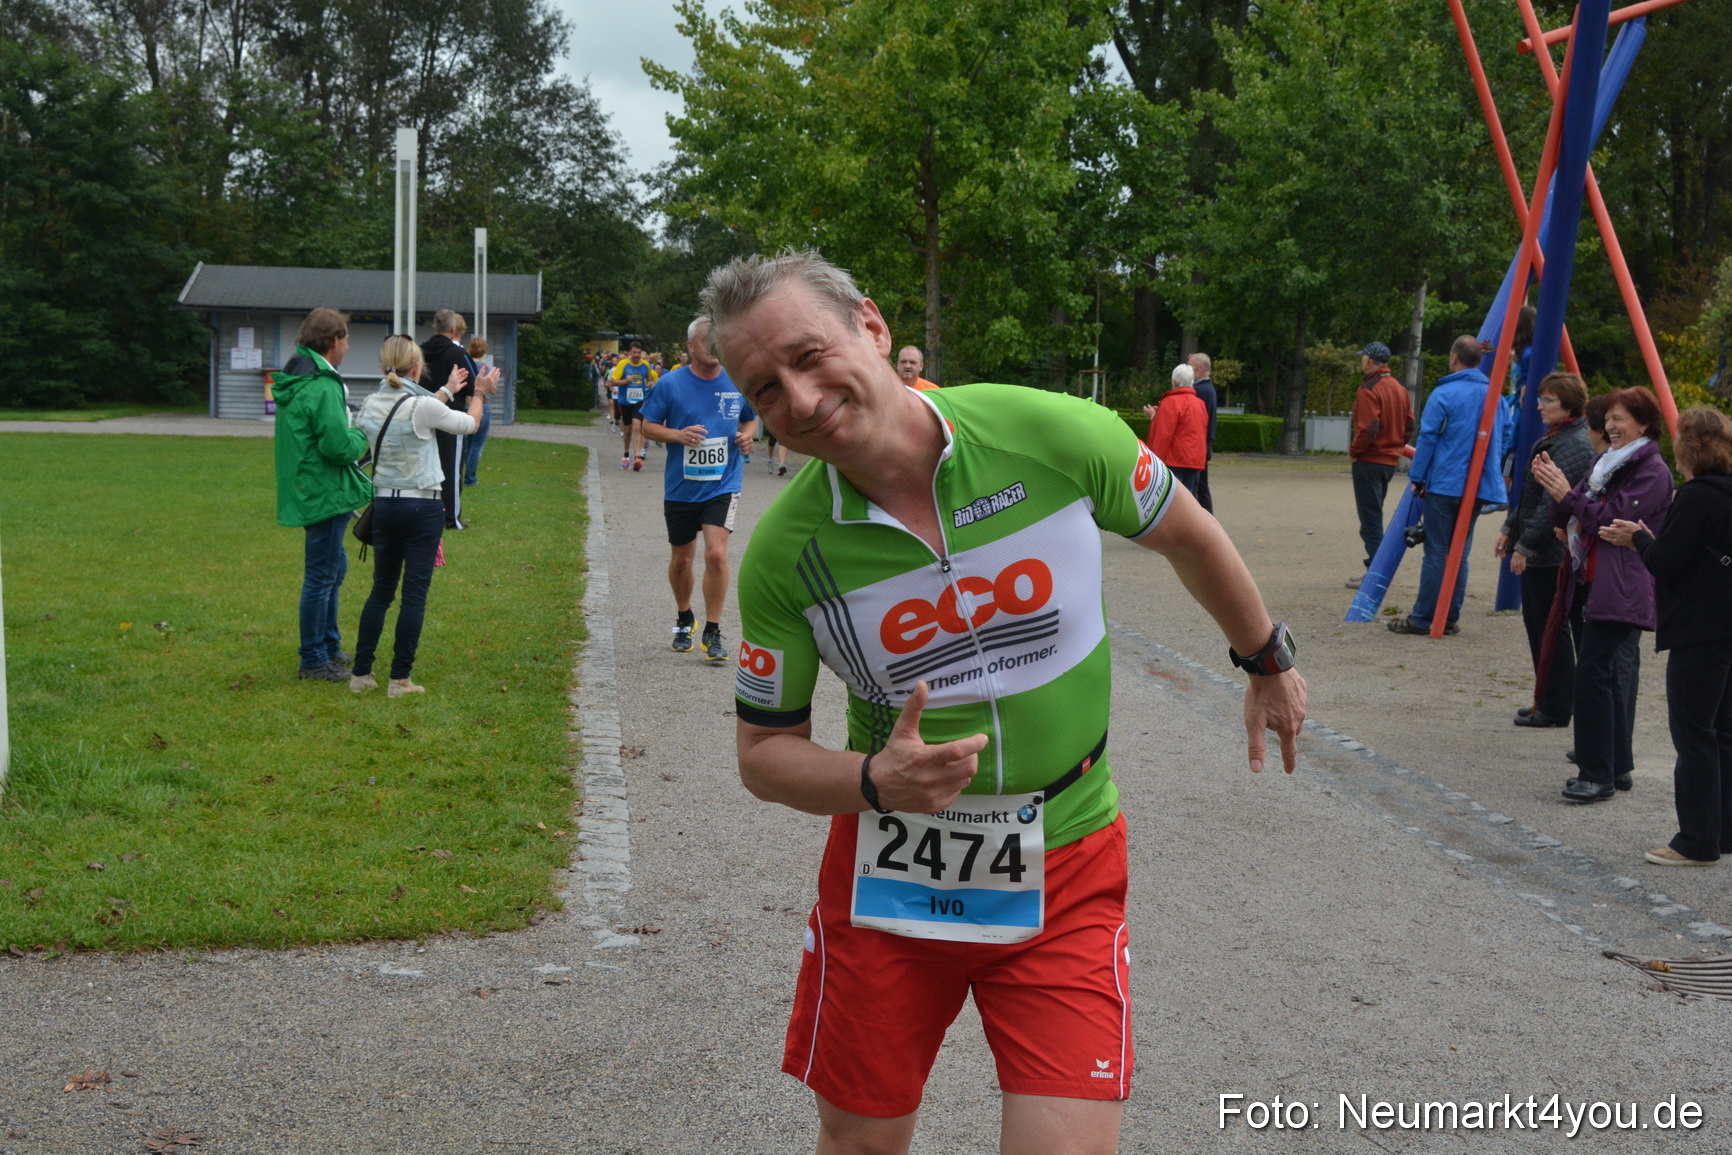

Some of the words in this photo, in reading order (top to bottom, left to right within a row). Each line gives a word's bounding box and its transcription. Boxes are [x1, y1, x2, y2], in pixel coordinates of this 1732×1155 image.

[688, 447, 725, 465] 2068
[1144, 501, 1156, 519] Der
[879, 558, 1053, 655] eco
[931, 810, 1009, 823] eumarkt
[876, 815, 1026, 882] 2474
[862, 864, 870, 875] D
[930, 895, 964, 916] Ivo
[1091, 1070, 1114, 1079] erima
